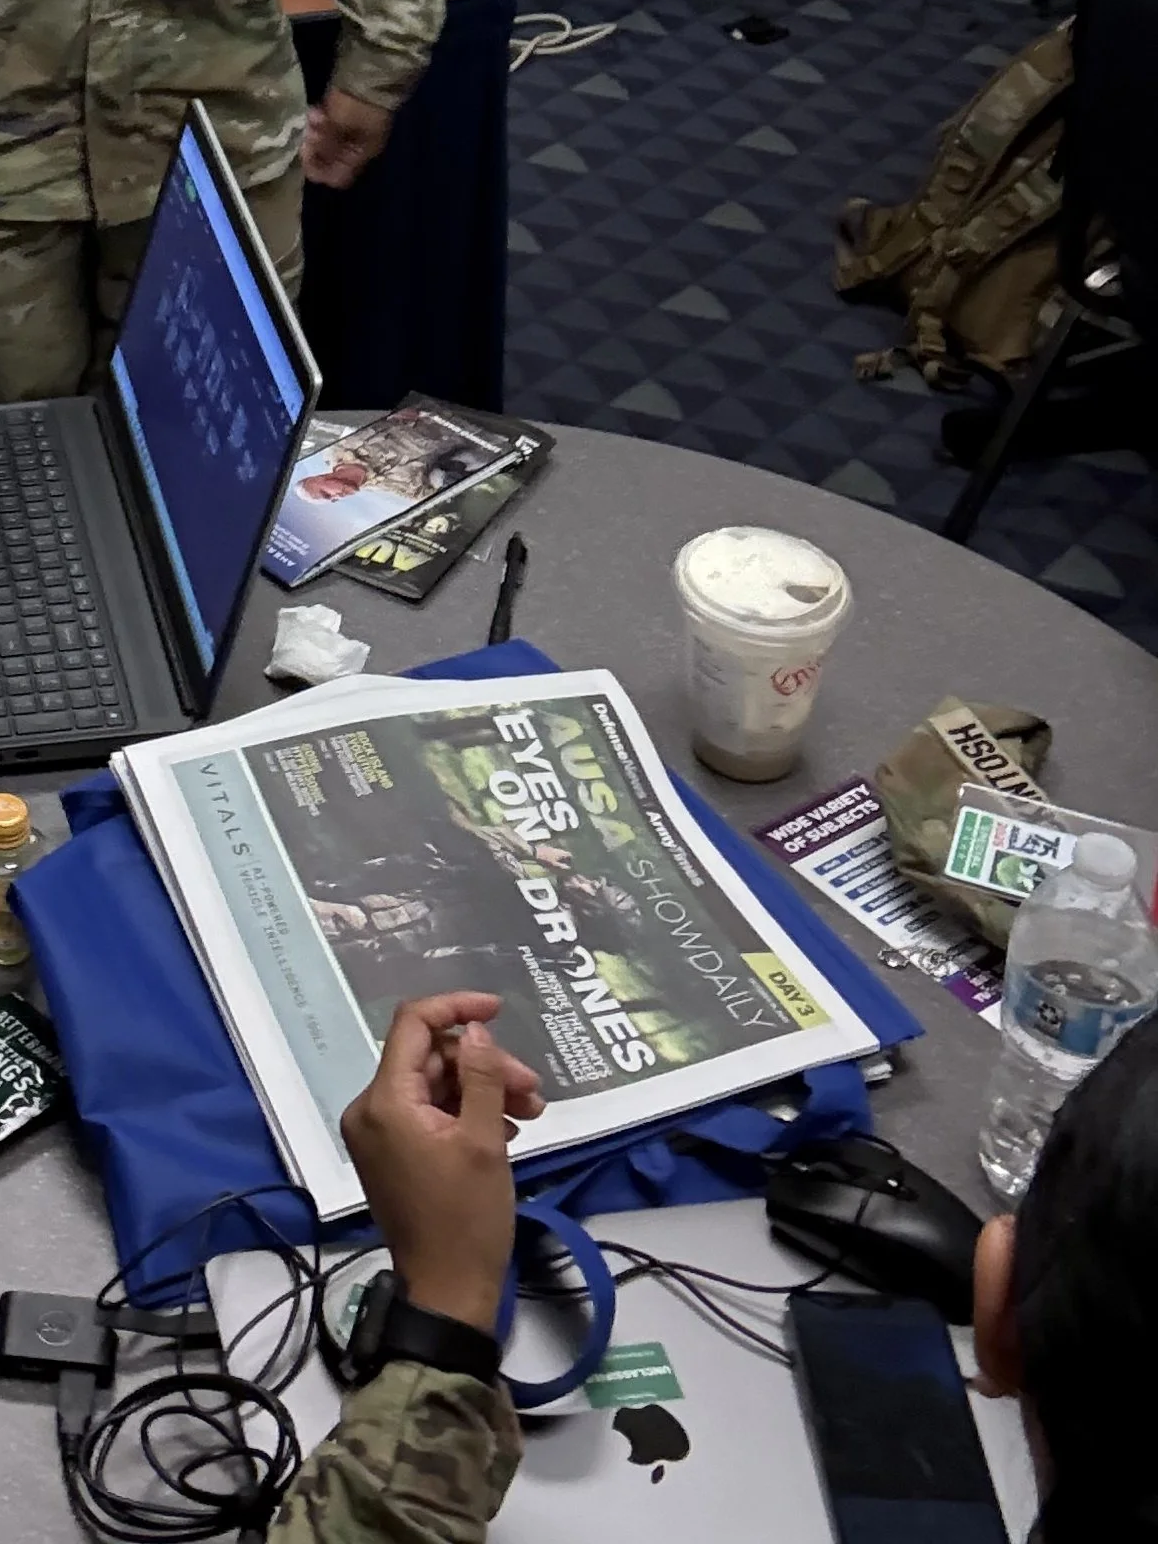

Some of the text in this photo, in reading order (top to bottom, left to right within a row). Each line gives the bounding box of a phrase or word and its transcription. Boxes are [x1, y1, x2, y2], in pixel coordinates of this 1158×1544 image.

[493, 708, 580, 833] EYES
[543, 712, 637, 853] AUSA
[947, 722, 1043, 803] NTOSH
[199, 761, 252, 857] VITALS
[488, 769, 552, 842] ON
[766, 783, 871, 842] WIDE VARIETY
[783, 799, 881, 853] OF SUBJECTS
[517, 944, 553, 1000] PURSUIT
[544, 995, 562, 1013] OF
[554, 1013, 600, 1082] UNMANNED
[542, 970, 573, 1009] INSIDE
[566, 1009, 586, 1035] THE
[768, 970, 804, 1005] DAY
[796, 1003, 815, 1017] 3
[541, 1012, 587, 1085] DOMINANCE
